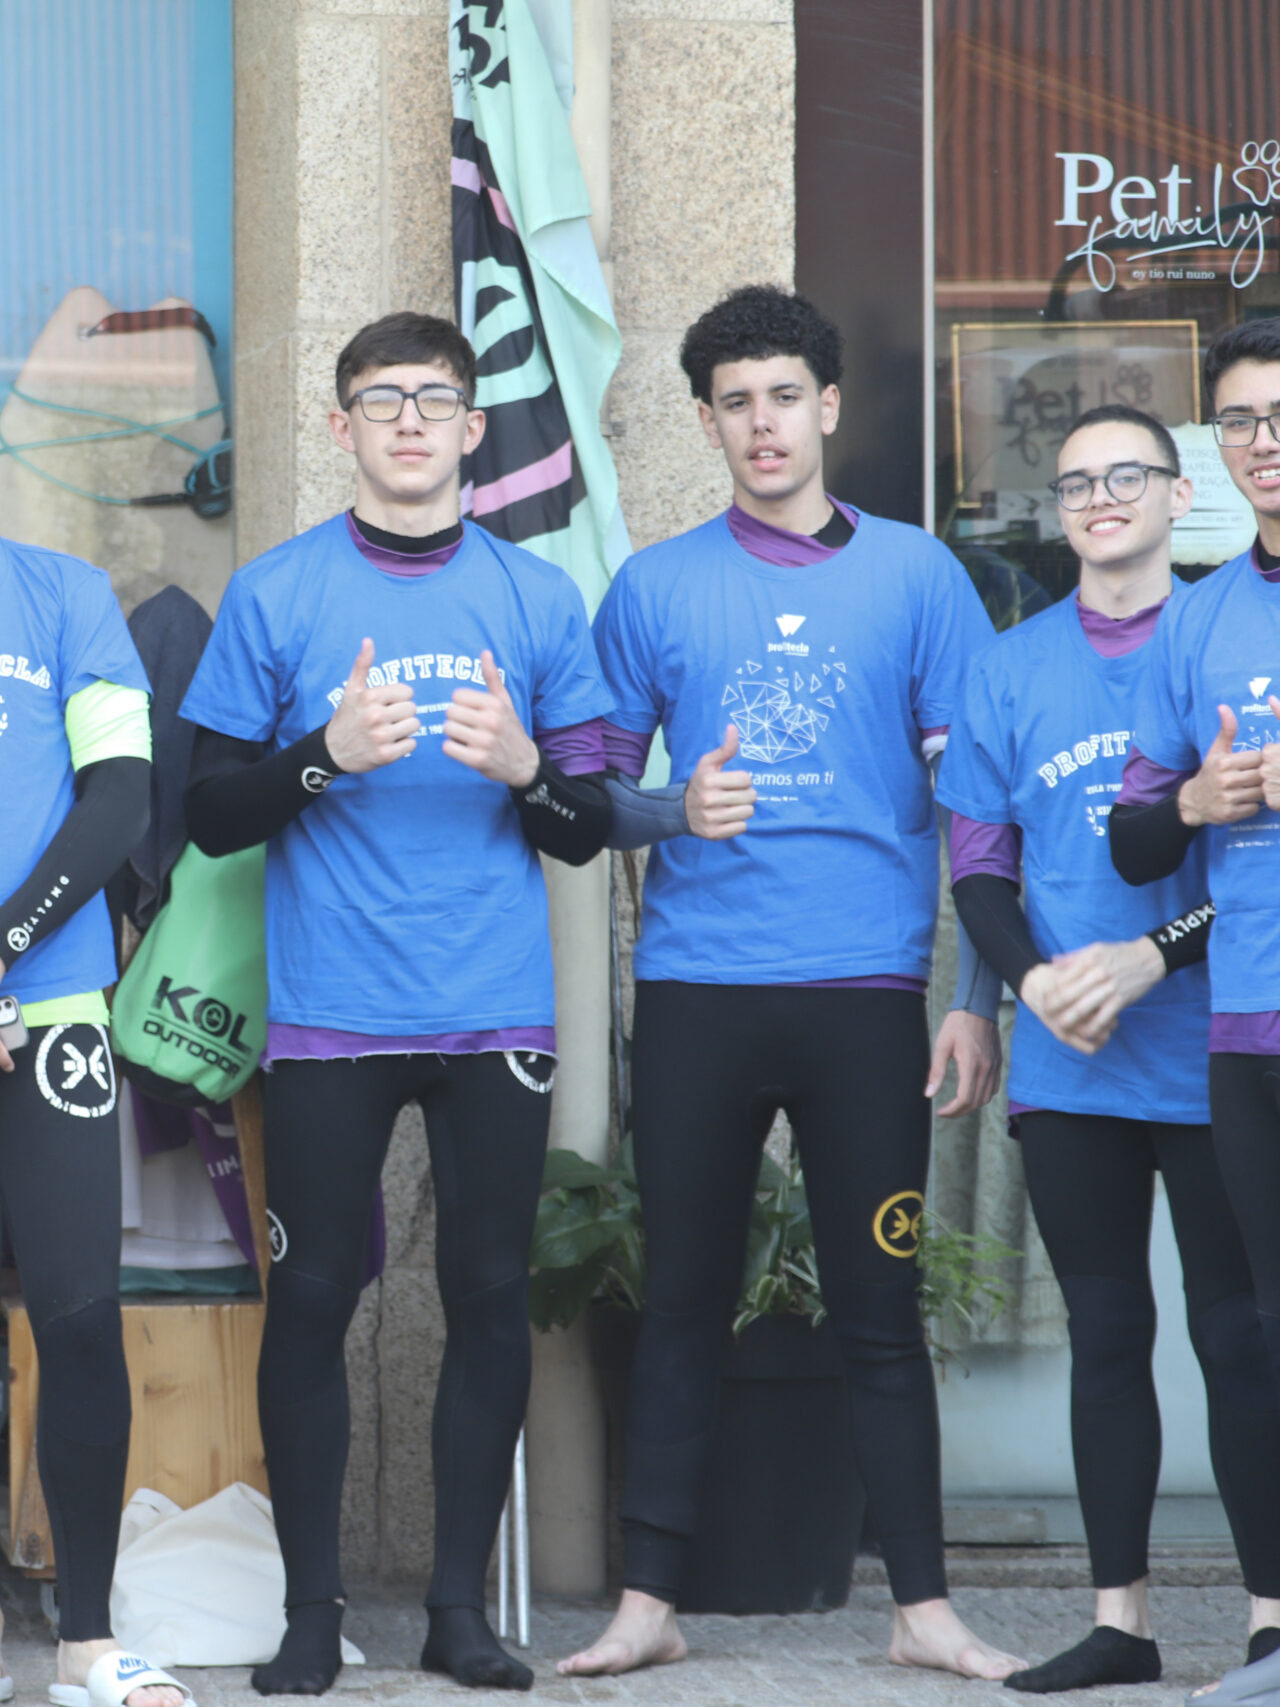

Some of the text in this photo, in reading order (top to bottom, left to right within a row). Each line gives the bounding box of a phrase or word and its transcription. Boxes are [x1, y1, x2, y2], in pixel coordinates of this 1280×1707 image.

[1054, 152, 1192, 226] Pet
[1065, 162, 1274, 293] family
[1149, 268, 1164, 279] tio
[1167, 268, 1183, 279] rui
[1186, 271, 1215, 280] nuno
[797, 772, 820, 785] em
[824, 770, 835, 785] ti
[1037, 731, 1136, 788] PROFIT
[151, 975, 254, 1054] KOL
[143, 1020, 241, 1079] OUTDOOR
